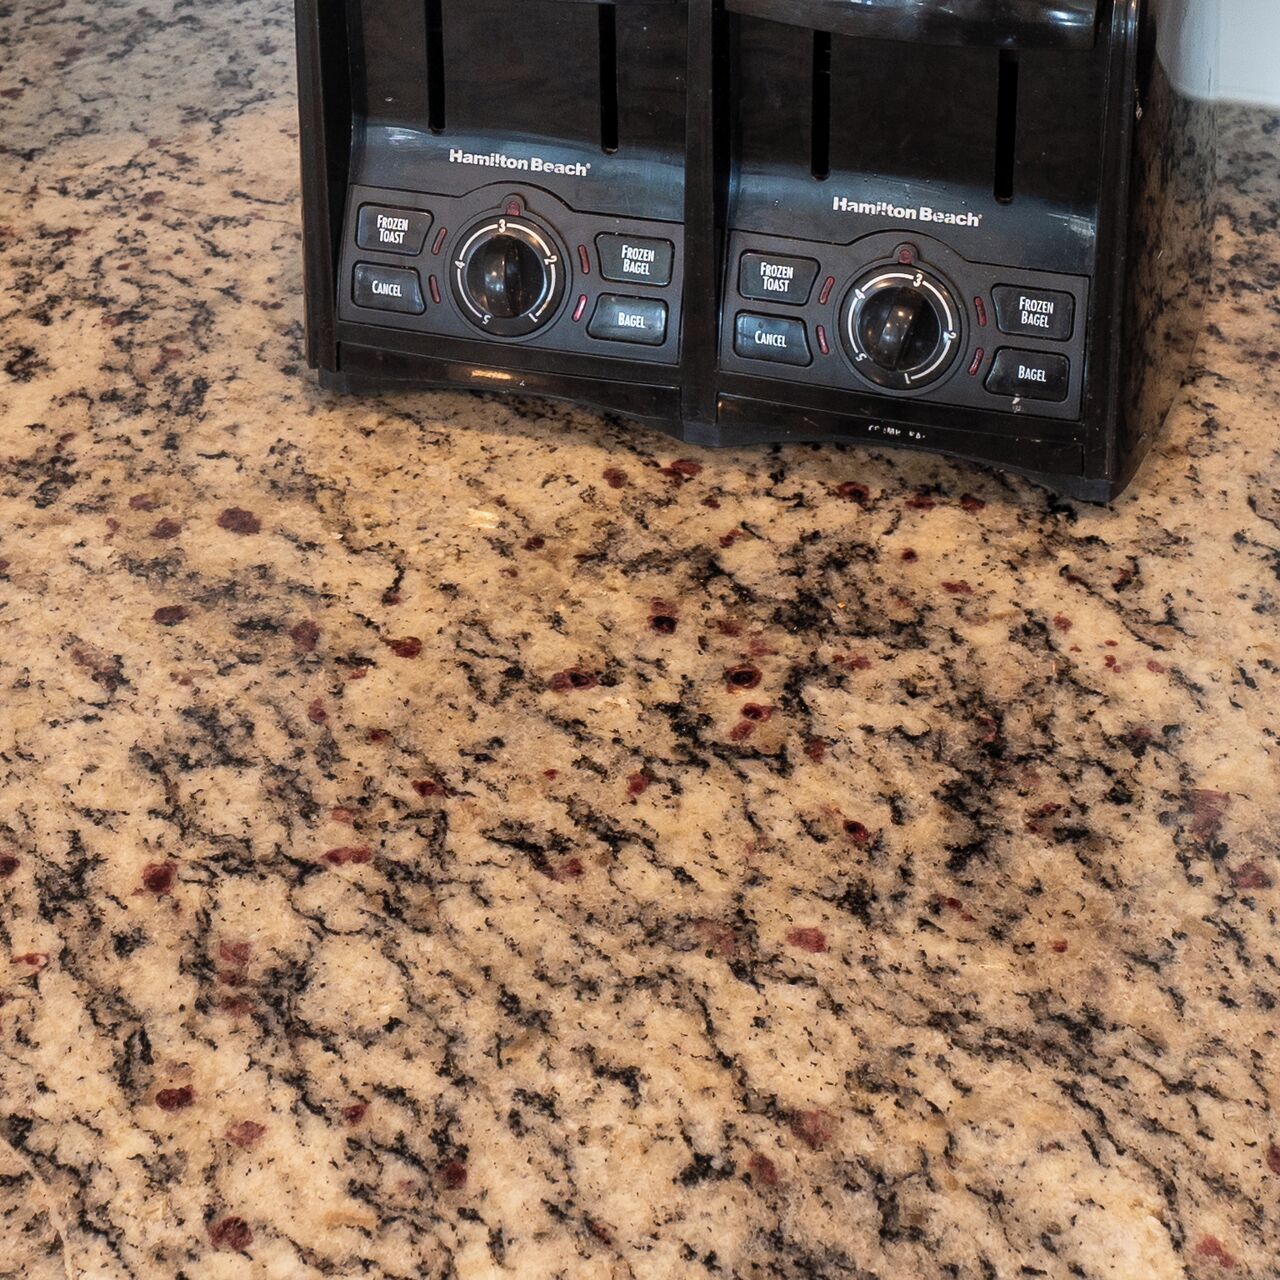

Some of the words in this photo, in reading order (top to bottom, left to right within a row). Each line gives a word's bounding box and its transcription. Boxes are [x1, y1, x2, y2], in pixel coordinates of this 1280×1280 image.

[449, 149, 529, 171] Hamilton
[833, 196, 917, 220] Hamilton
[498, 219, 506, 233] 3
[454, 258, 466, 269] 4
[544, 255, 558, 266] 2
[913, 274, 923, 287] 3
[855, 288, 866, 300] 4
[481, 314, 492, 325] 5
[944, 330, 957, 341] 2
[857, 352, 868, 362] 5
